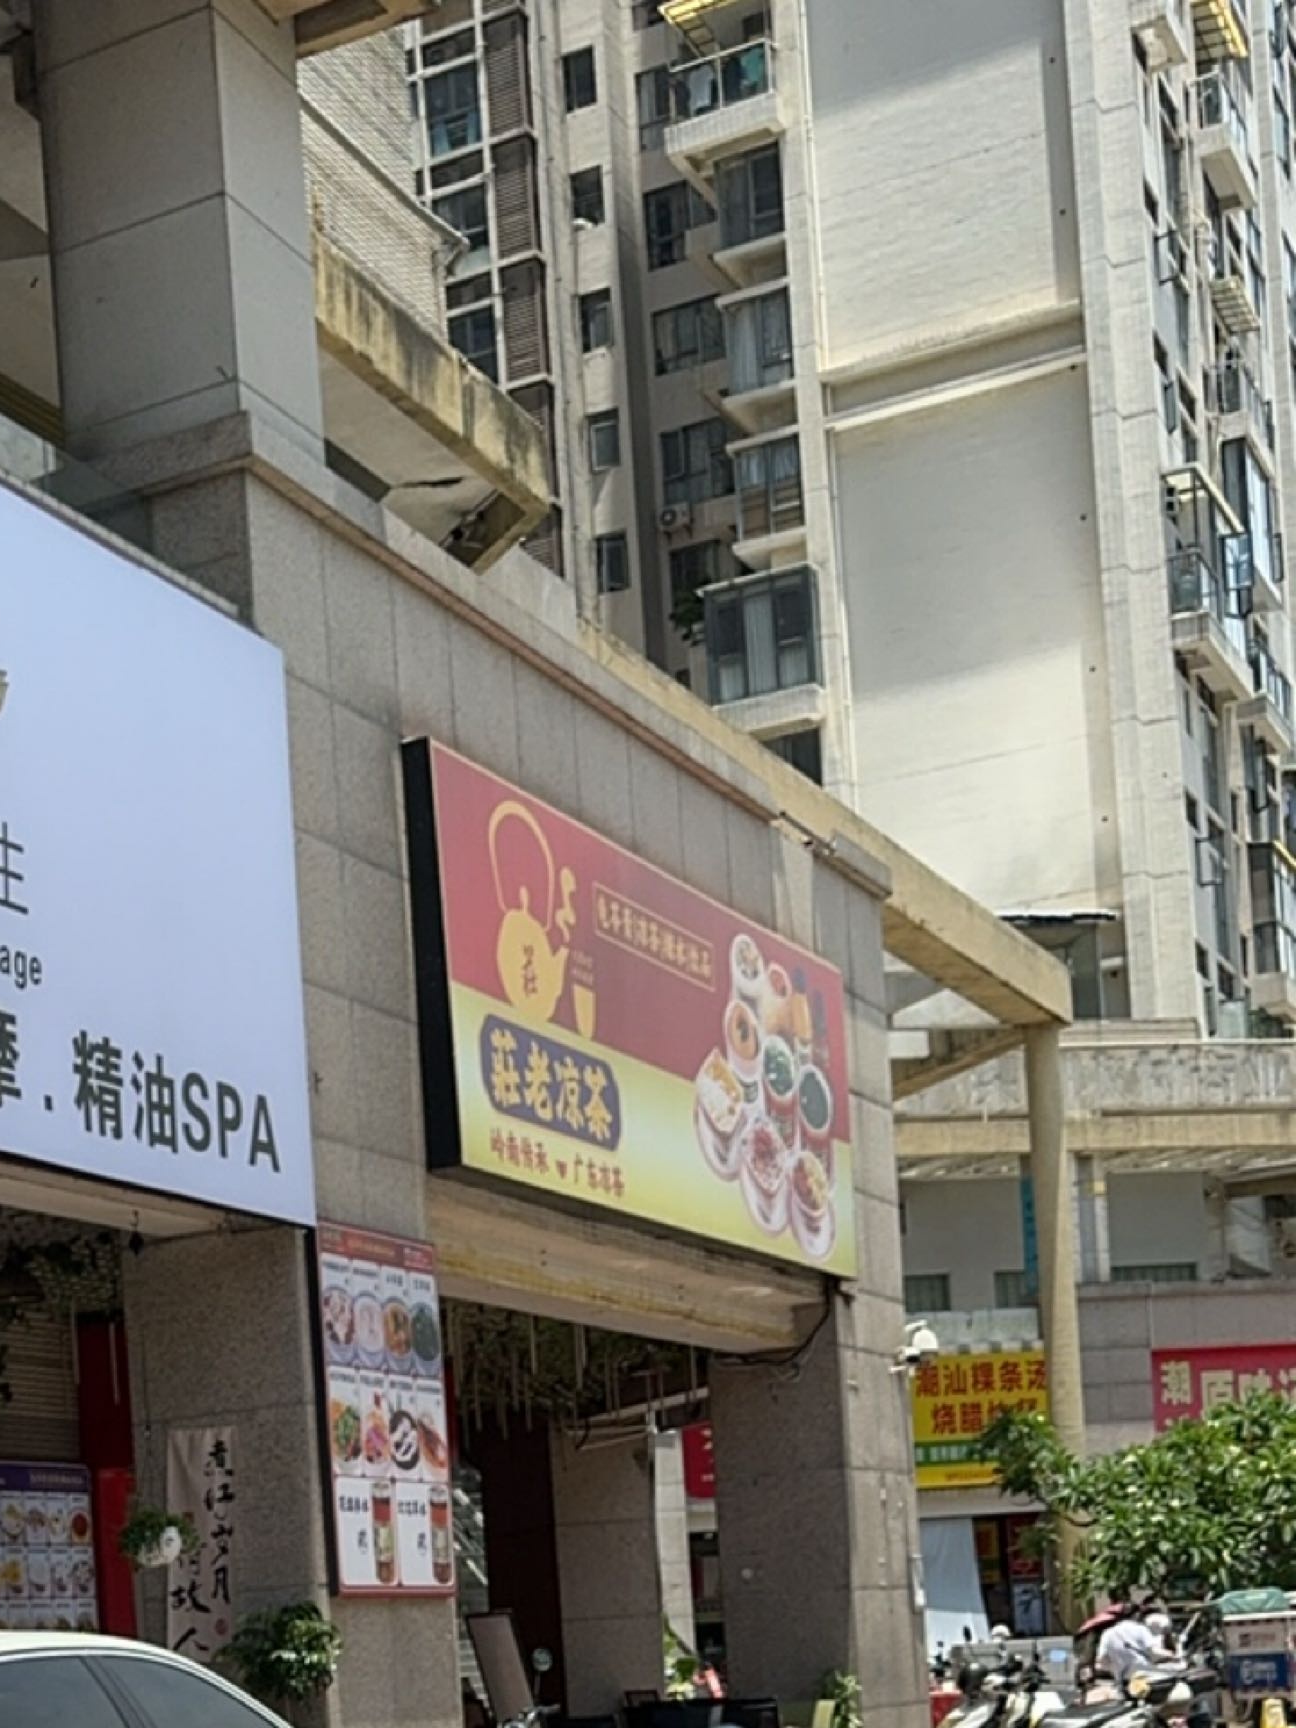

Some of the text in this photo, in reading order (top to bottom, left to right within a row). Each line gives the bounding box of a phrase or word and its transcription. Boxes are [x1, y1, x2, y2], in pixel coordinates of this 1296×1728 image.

[915, 1360, 1047, 1397] 潮汕粿条汤
[932, 1397, 1039, 1434] 烧腊
